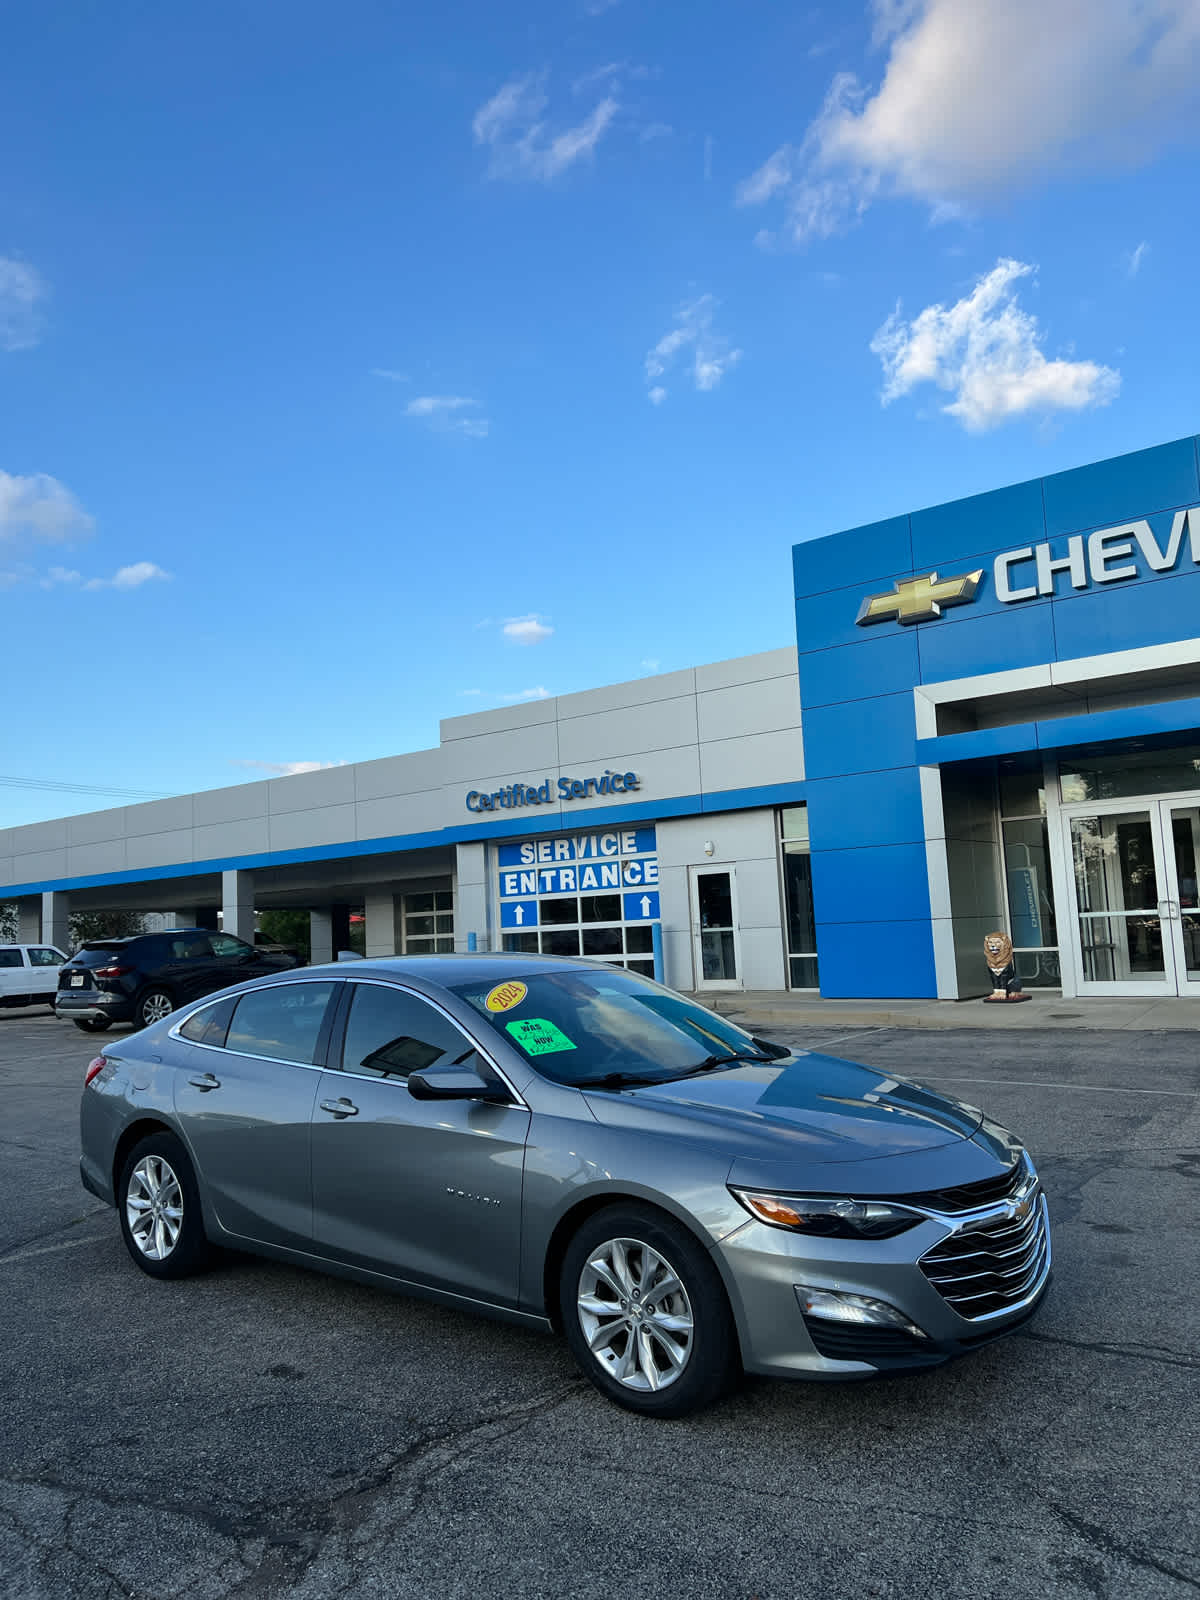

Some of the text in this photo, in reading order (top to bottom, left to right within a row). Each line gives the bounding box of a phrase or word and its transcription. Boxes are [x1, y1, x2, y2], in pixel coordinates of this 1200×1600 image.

[993, 506, 1200, 603] CHEV
[466, 769, 638, 813] Certified Service
[520, 831, 638, 864] SERVICE
[505, 861, 659, 895] ENTRANCE
[492, 983, 523, 1009] 2024
[520, 1023, 542, 1033] WAS
[534, 1036, 554, 1045] NOW
